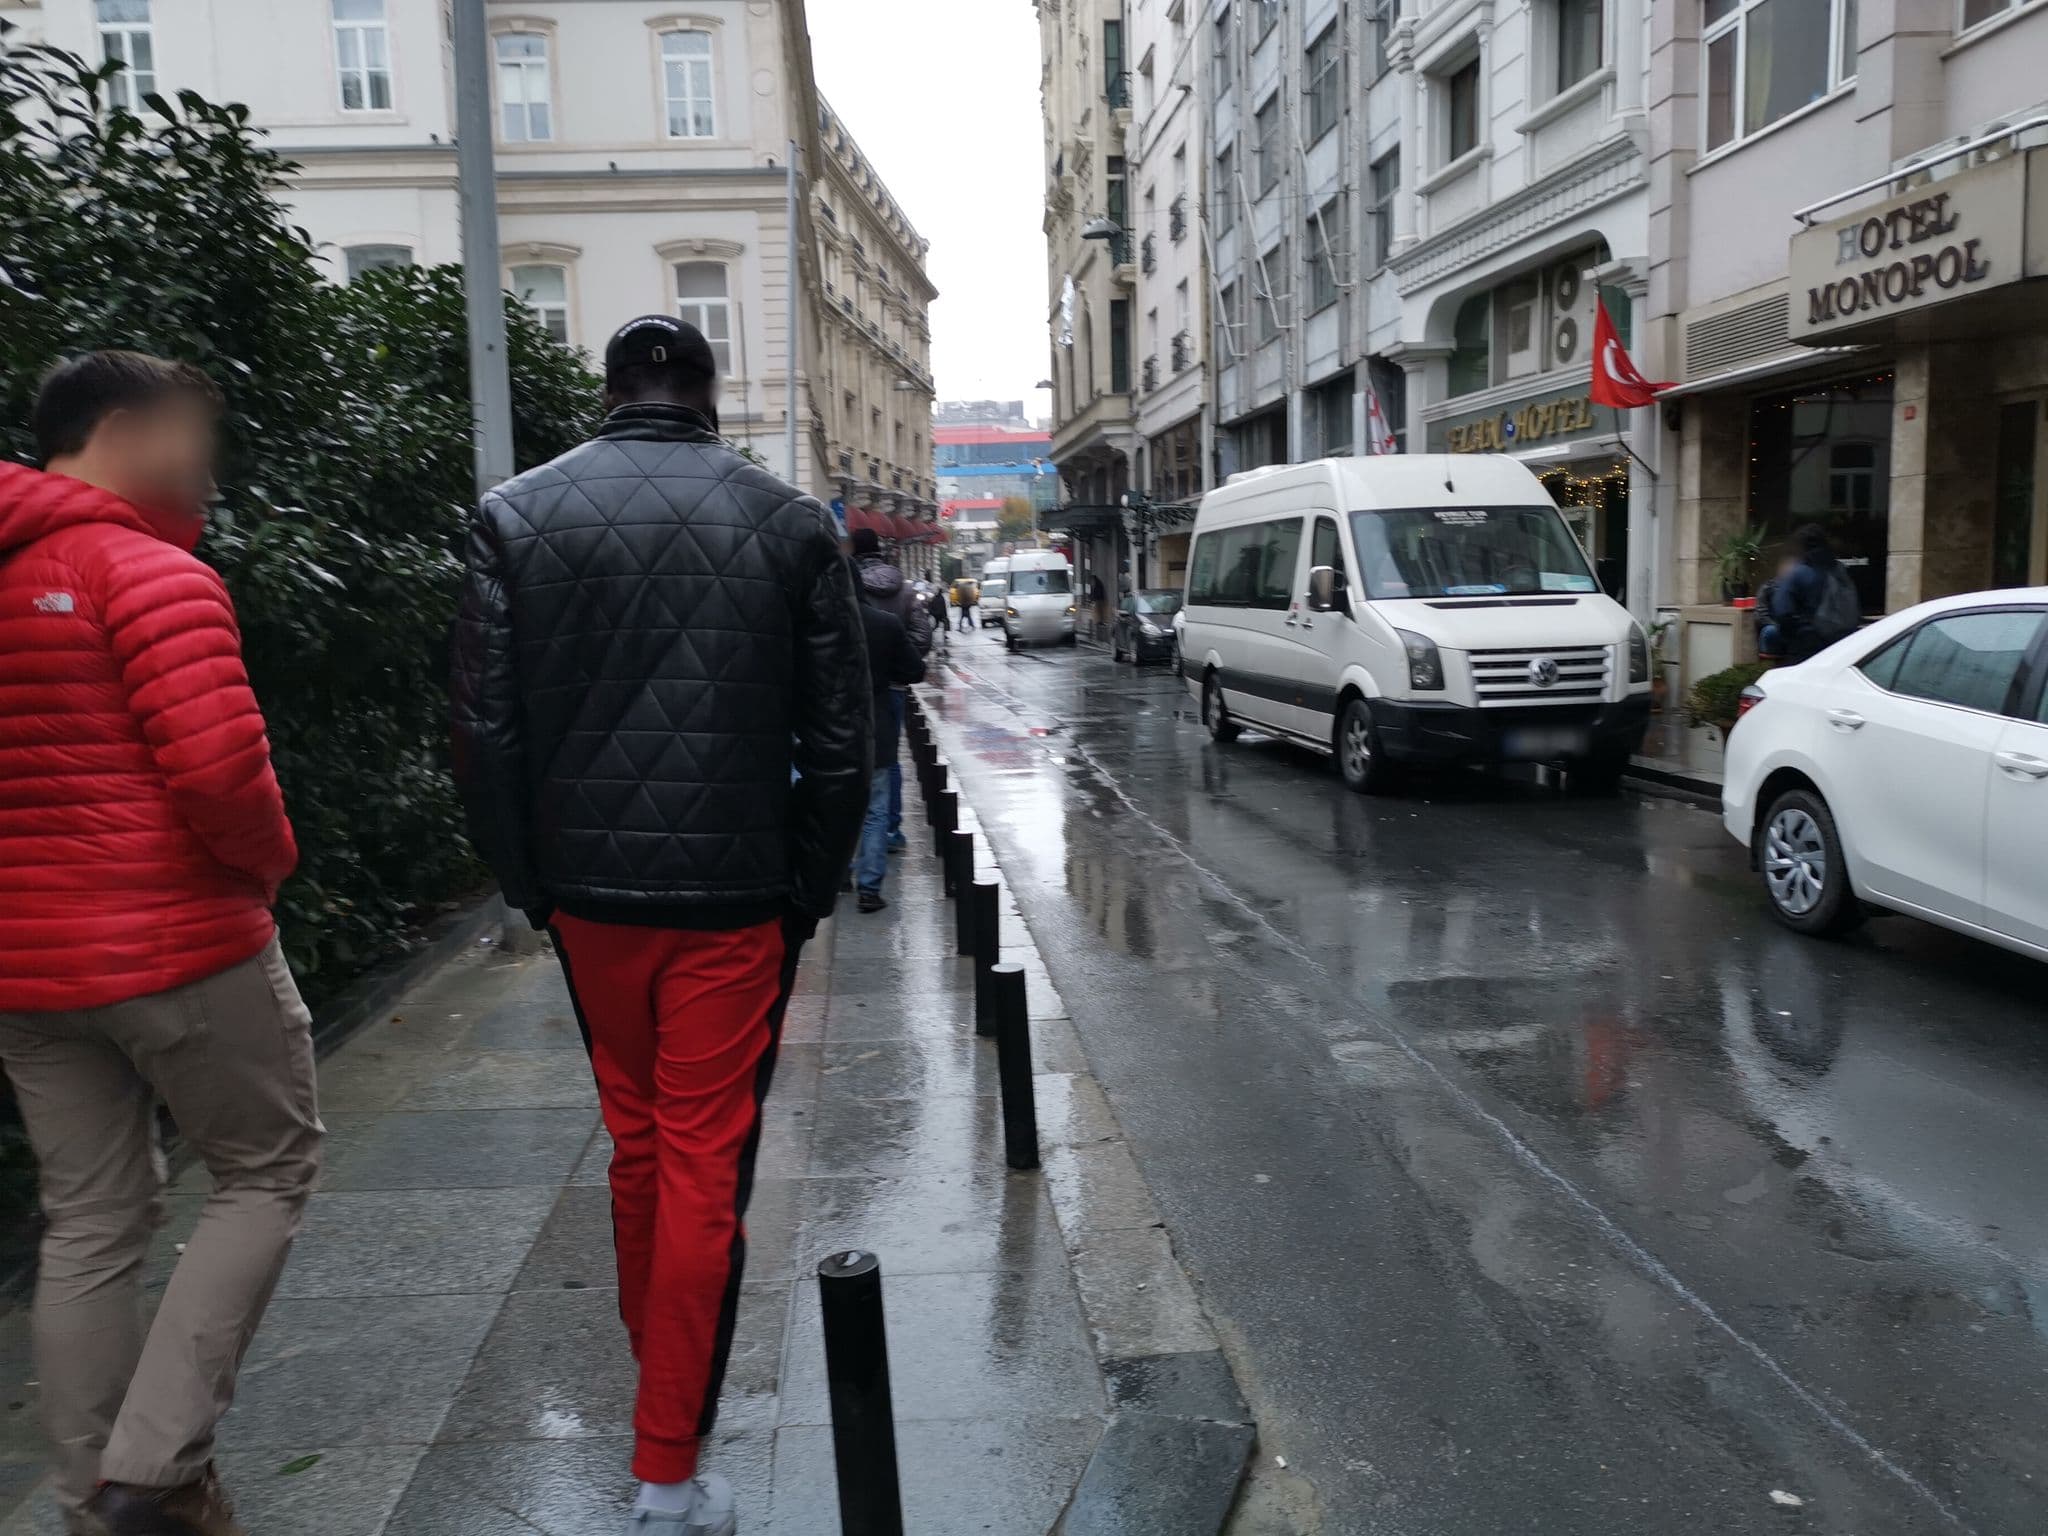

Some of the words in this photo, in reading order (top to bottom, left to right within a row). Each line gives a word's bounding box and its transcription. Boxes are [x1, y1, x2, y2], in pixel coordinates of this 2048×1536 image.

[1836, 192, 1961, 265] HOTEL
[1808, 238, 1991, 325] MONOPOL
[1514, 397, 1593, 443] HOTEL
